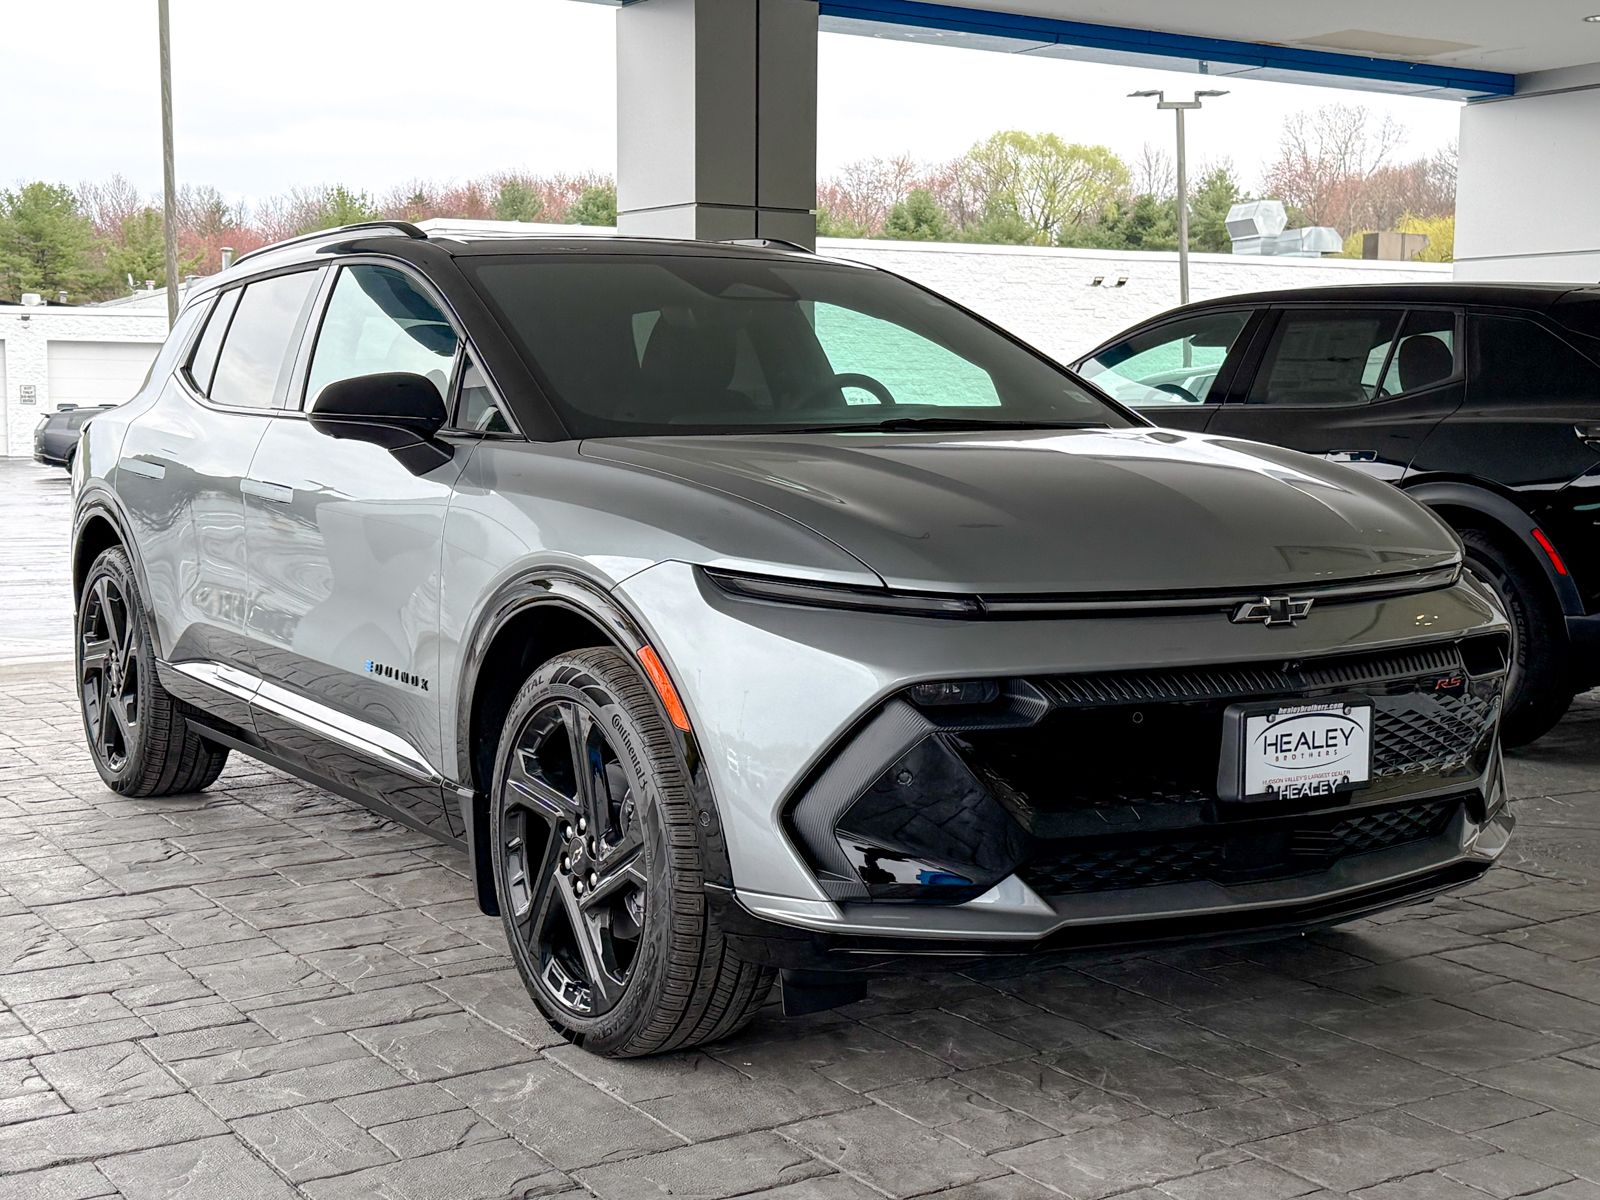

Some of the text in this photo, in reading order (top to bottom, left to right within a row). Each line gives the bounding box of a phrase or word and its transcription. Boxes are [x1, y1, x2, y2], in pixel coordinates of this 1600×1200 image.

[1435, 676, 1462, 691] RS
[611, 713, 646, 781] Continental
[1264, 726, 1355, 755] HEALEY
[1275, 749, 1338, 762] BROTHERS
[1280, 780, 1339, 800] HEALEY
